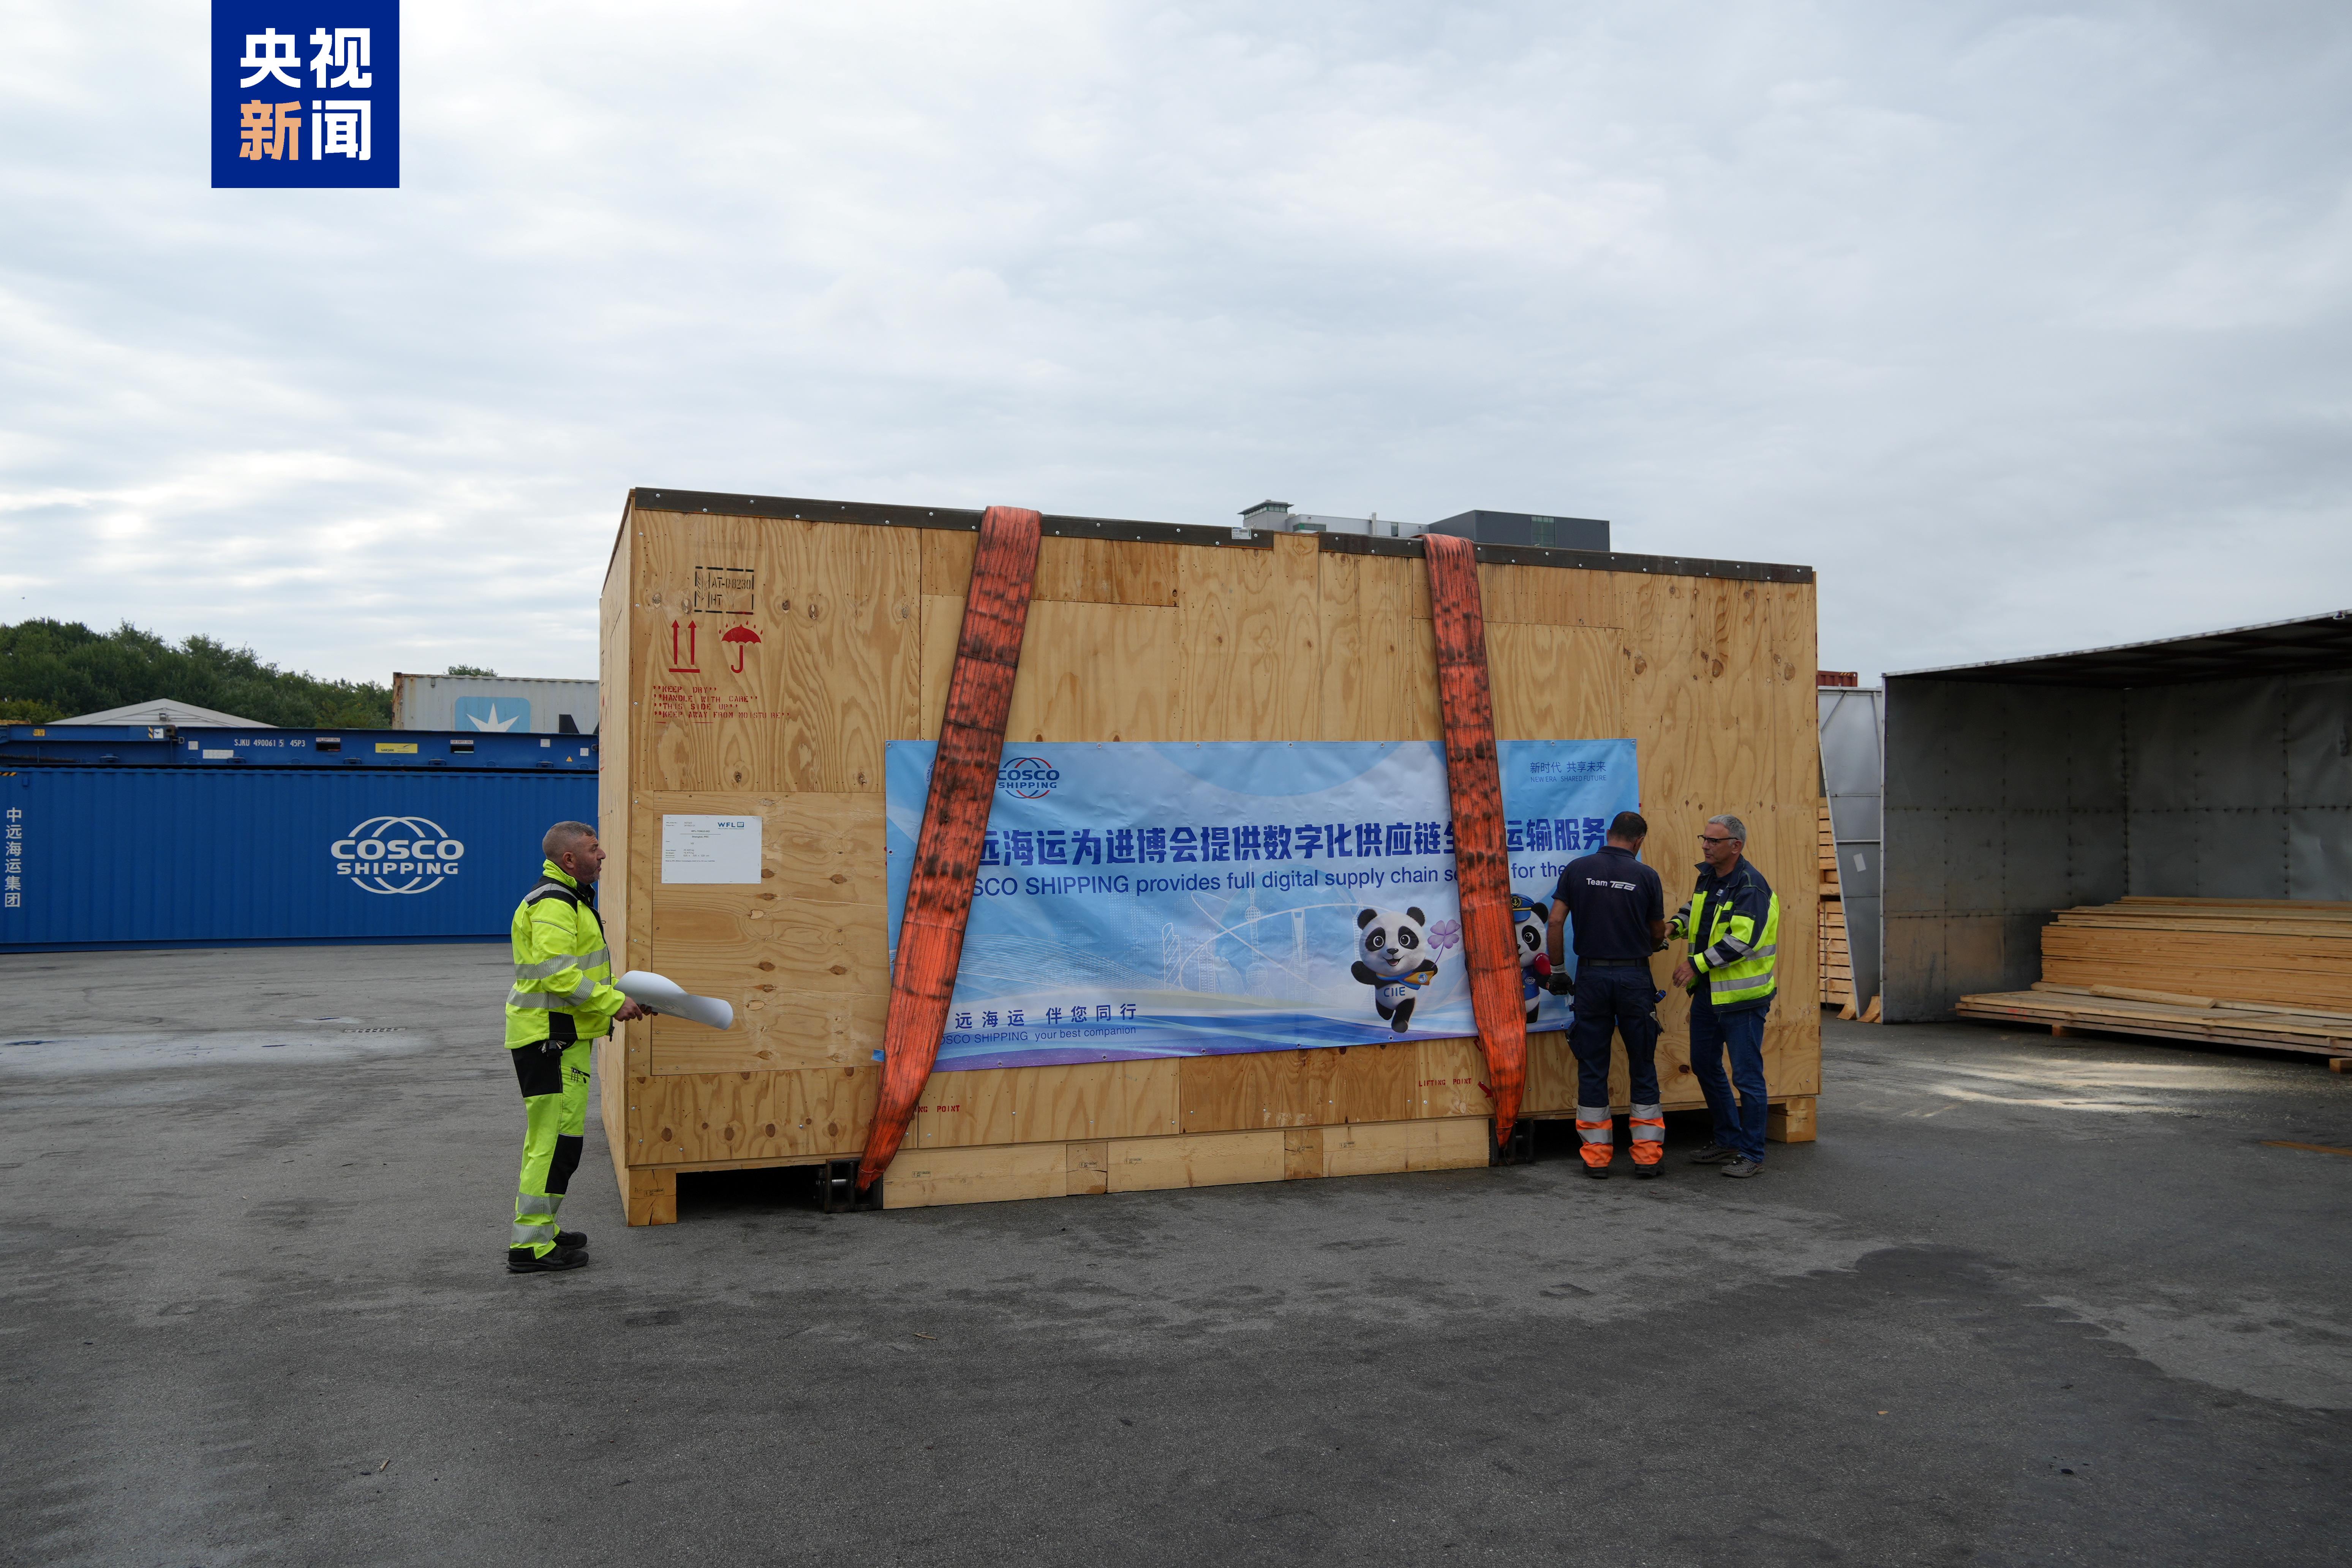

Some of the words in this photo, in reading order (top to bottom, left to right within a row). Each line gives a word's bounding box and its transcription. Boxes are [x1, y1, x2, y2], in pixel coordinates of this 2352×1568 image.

[711, 594, 722, 605] HT
[1530, 762, 1562, 773] 新时代
[1566, 761, 1607, 773] 共享未来
[997, 770, 1060, 781] COSCO
[331, 839, 464, 860] COSCO
[5, 807, 22, 908] 中远海运集团
[337, 863, 458, 875] SHIPPING
[973, 877, 1018, 896] SCO
[1025, 875, 1129, 895] SHIPPING
[1136, 873, 1220, 896] provides
[1227, 871, 1254, 889] full
[1262, 869, 1318, 891] digital
[1325, 868, 1385, 889] supply
[1391, 866, 1438, 883] chain
[1511, 863, 1535, 879] for
[1586, 878, 1608, 887] Team
[1384, 986, 1405, 997] CIIE
[1045, 1003, 1136, 1024] 伴您同行
[940, 1034, 970, 1045] OSCO
[974, 1031, 1028, 1043] SHIPPING
[1035, 1032, 1057, 1042] your
[1060, 1029, 1081, 1038] best
[1084, 1026, 1136, 1038] companion
